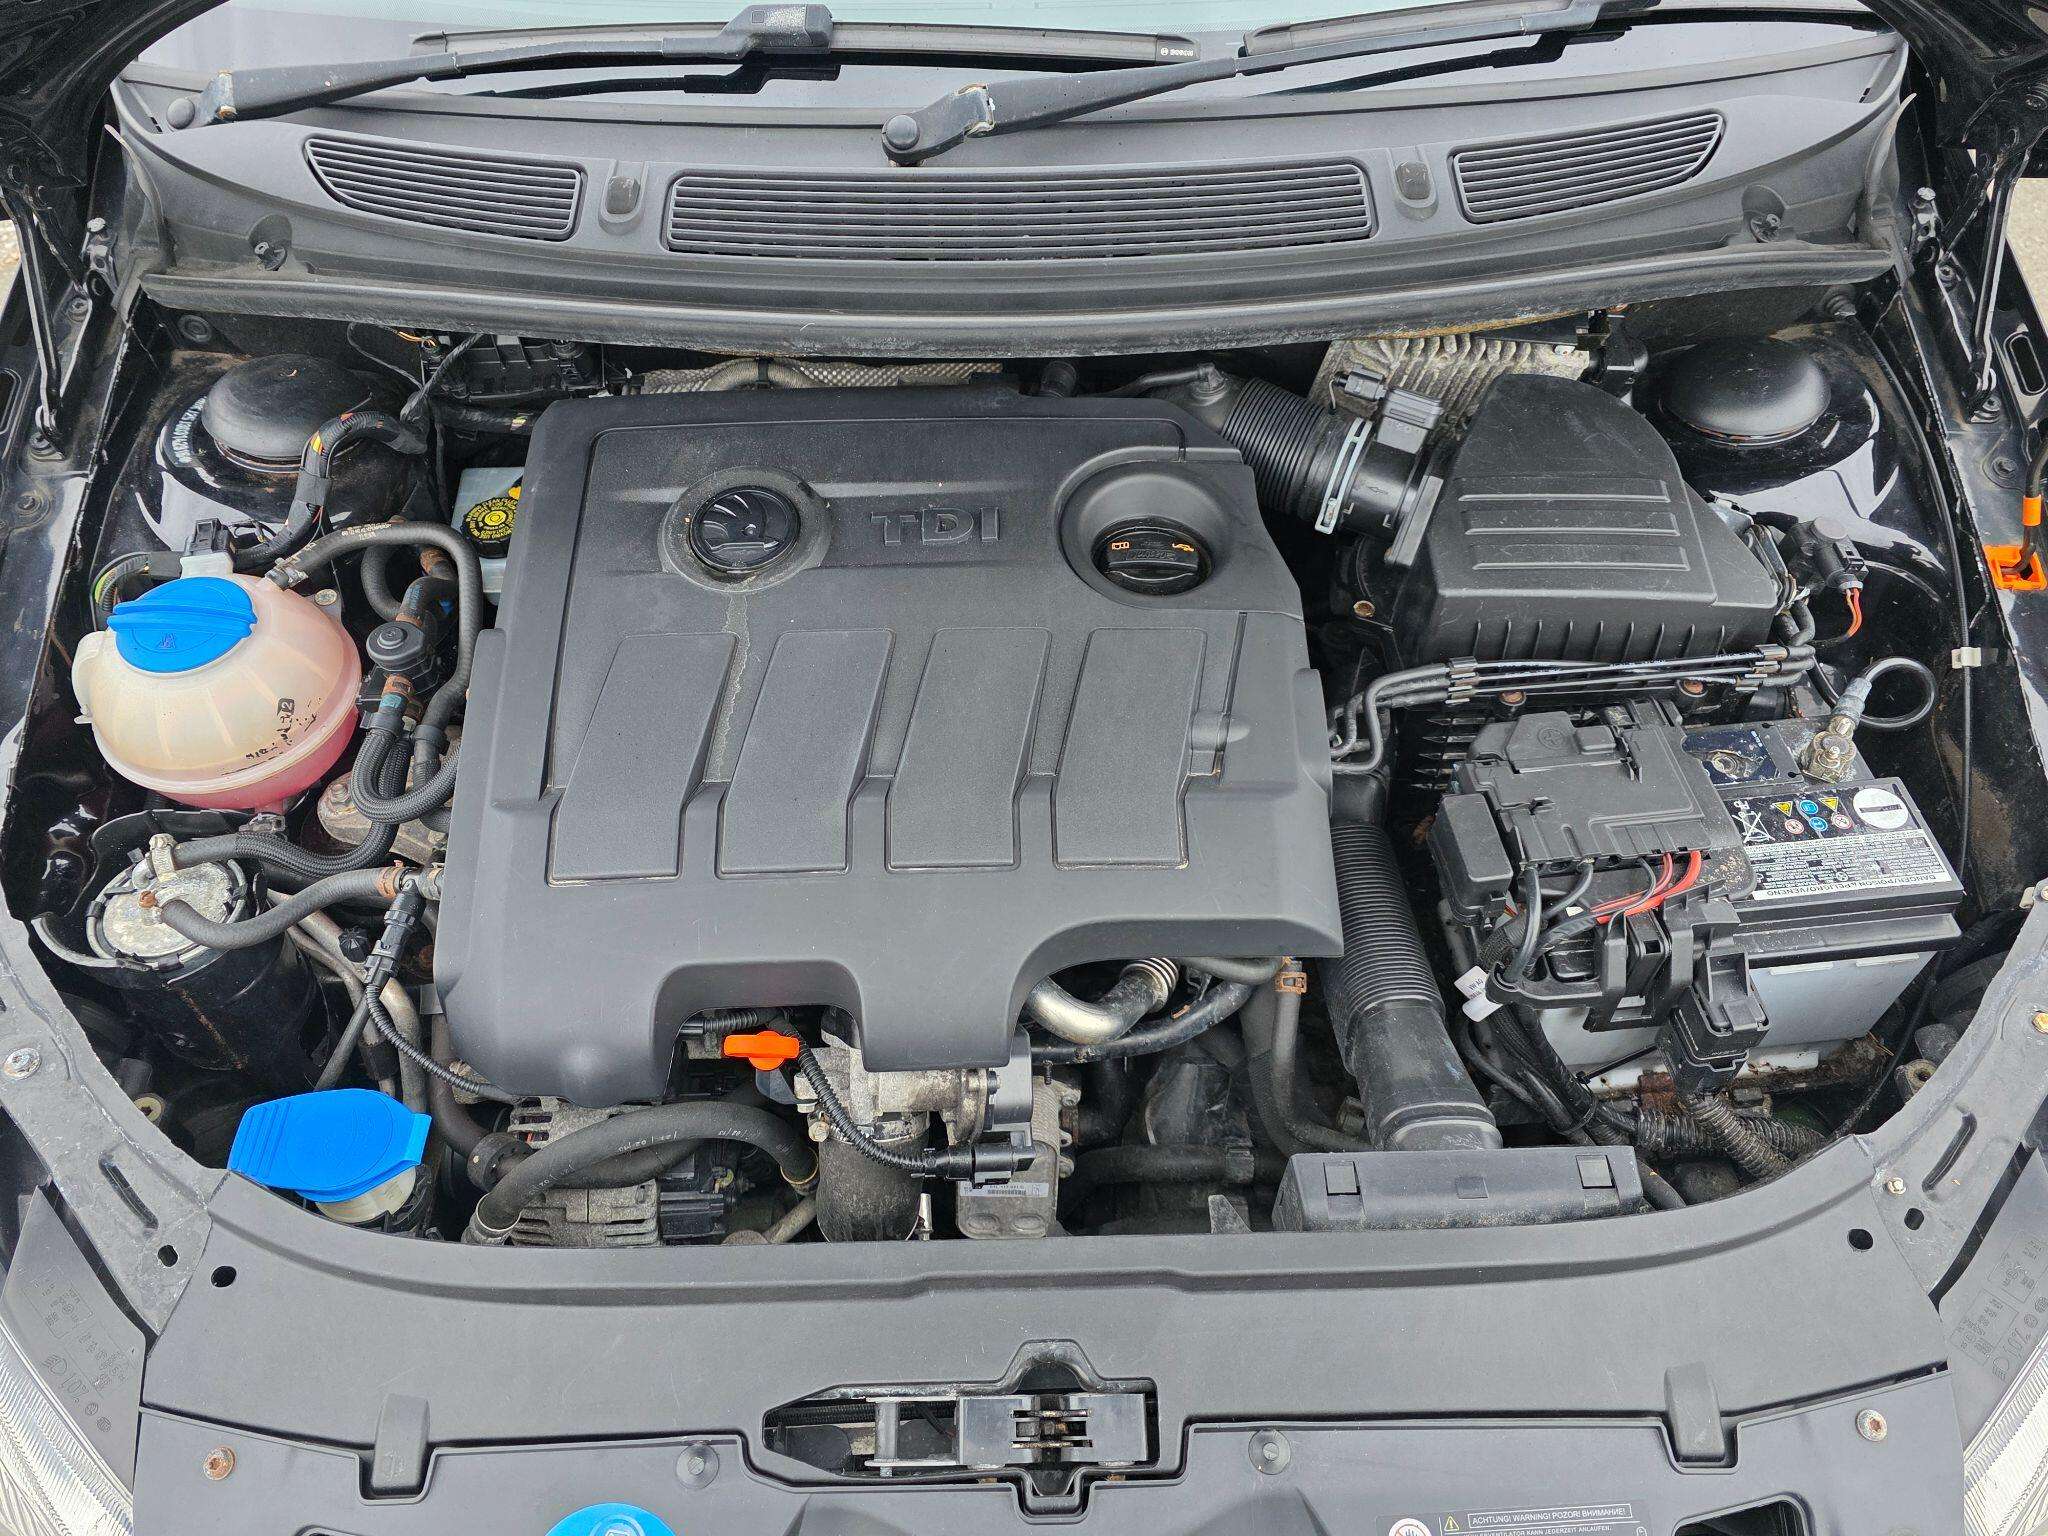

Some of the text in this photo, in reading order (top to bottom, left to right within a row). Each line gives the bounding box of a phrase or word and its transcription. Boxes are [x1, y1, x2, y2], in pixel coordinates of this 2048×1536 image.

[870, 506, 999, 546] TDI
[1472, 1510, 1581, 1525] ACHTUNG! WARNING! POZOR!
[1582, 1507, 1626, 1517] ВНИМАНИЕ!
[1545, 1526, 1577, 1535] JEDERZEIT
